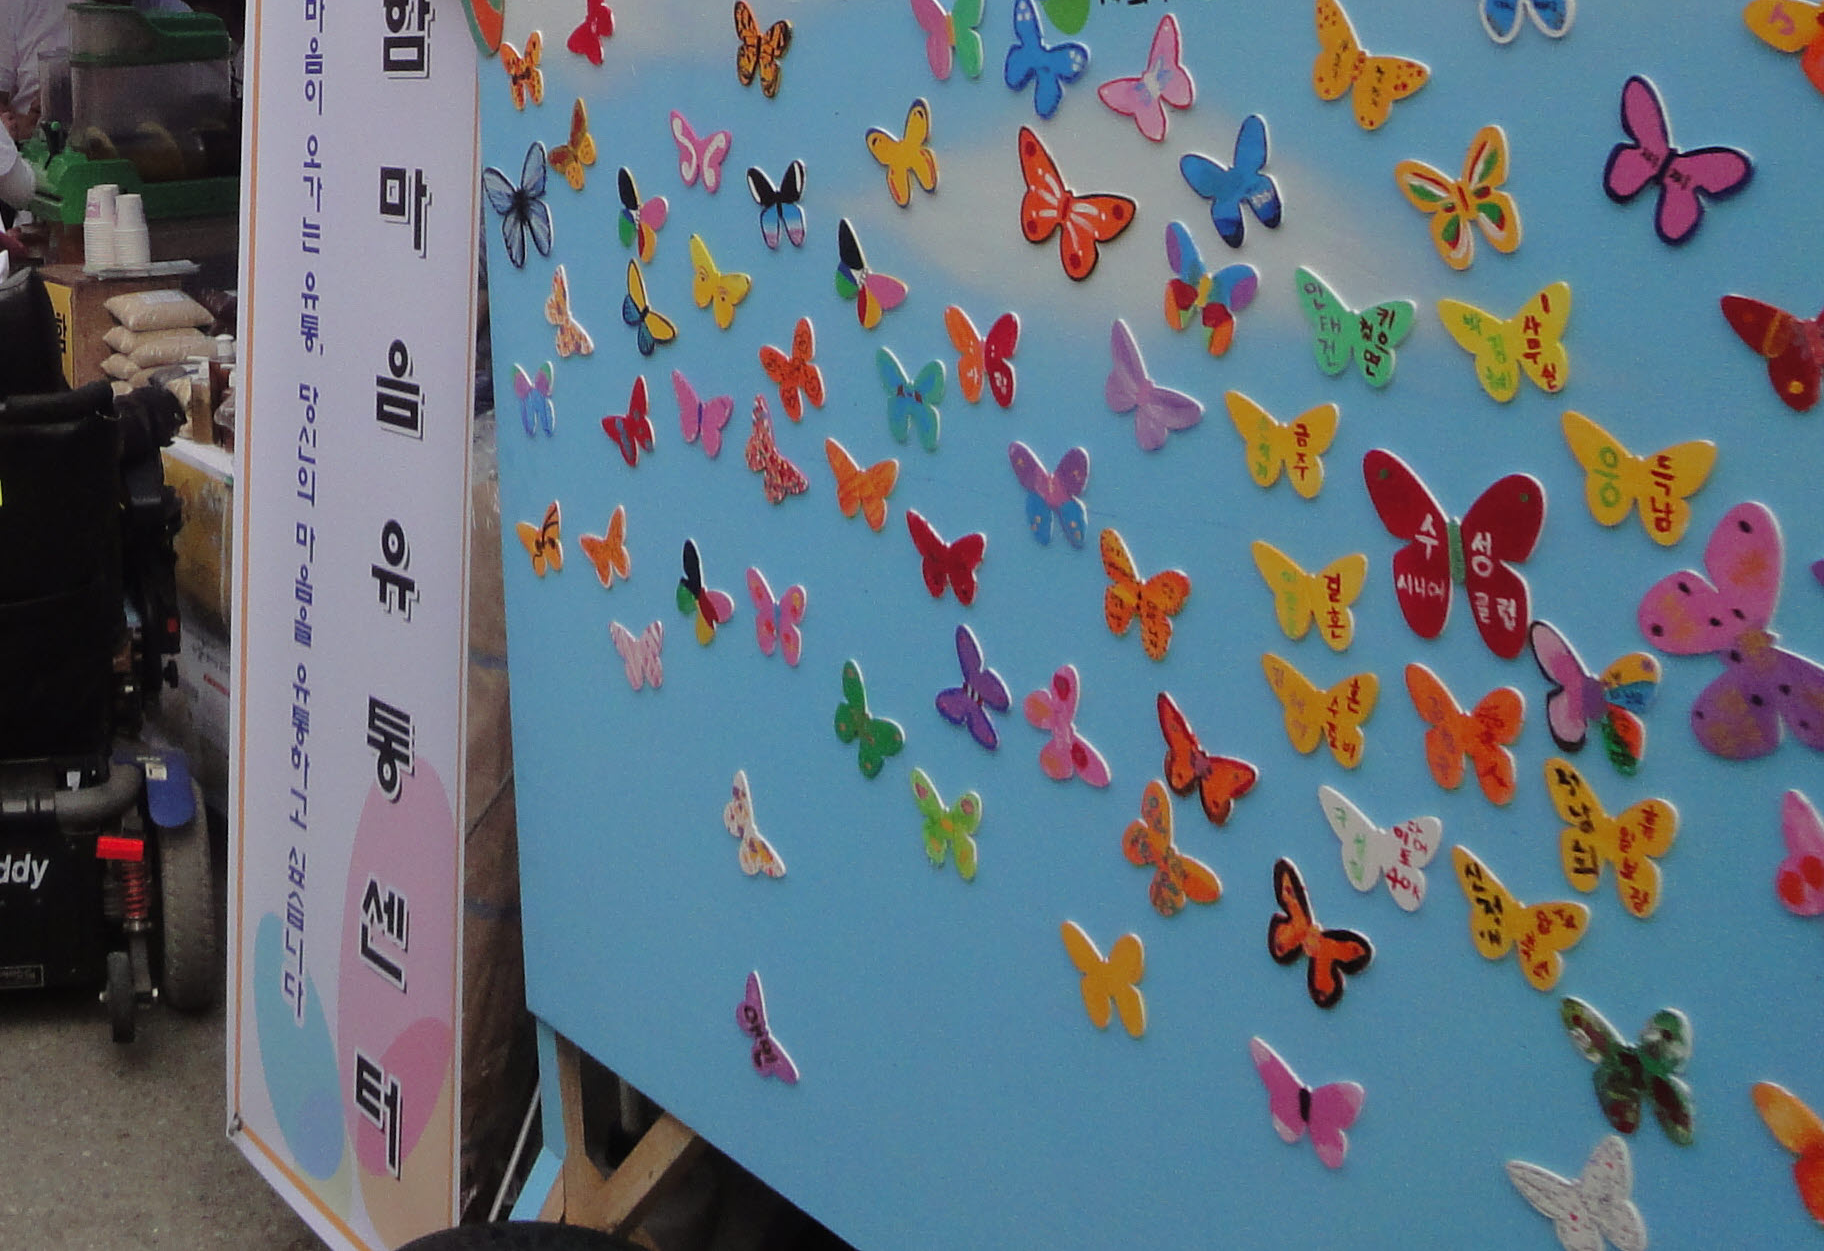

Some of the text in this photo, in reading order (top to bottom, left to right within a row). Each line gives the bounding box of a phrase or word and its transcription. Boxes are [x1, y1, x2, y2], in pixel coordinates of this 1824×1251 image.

[300, 134, 323, 255] 오가는
[298, 270, 325, 356] 유통,
[295, 382, 319, 508] 당신의
[292, 521, 316, 649] 마음을
[283, 846, 308, 1019] 싶습니다
